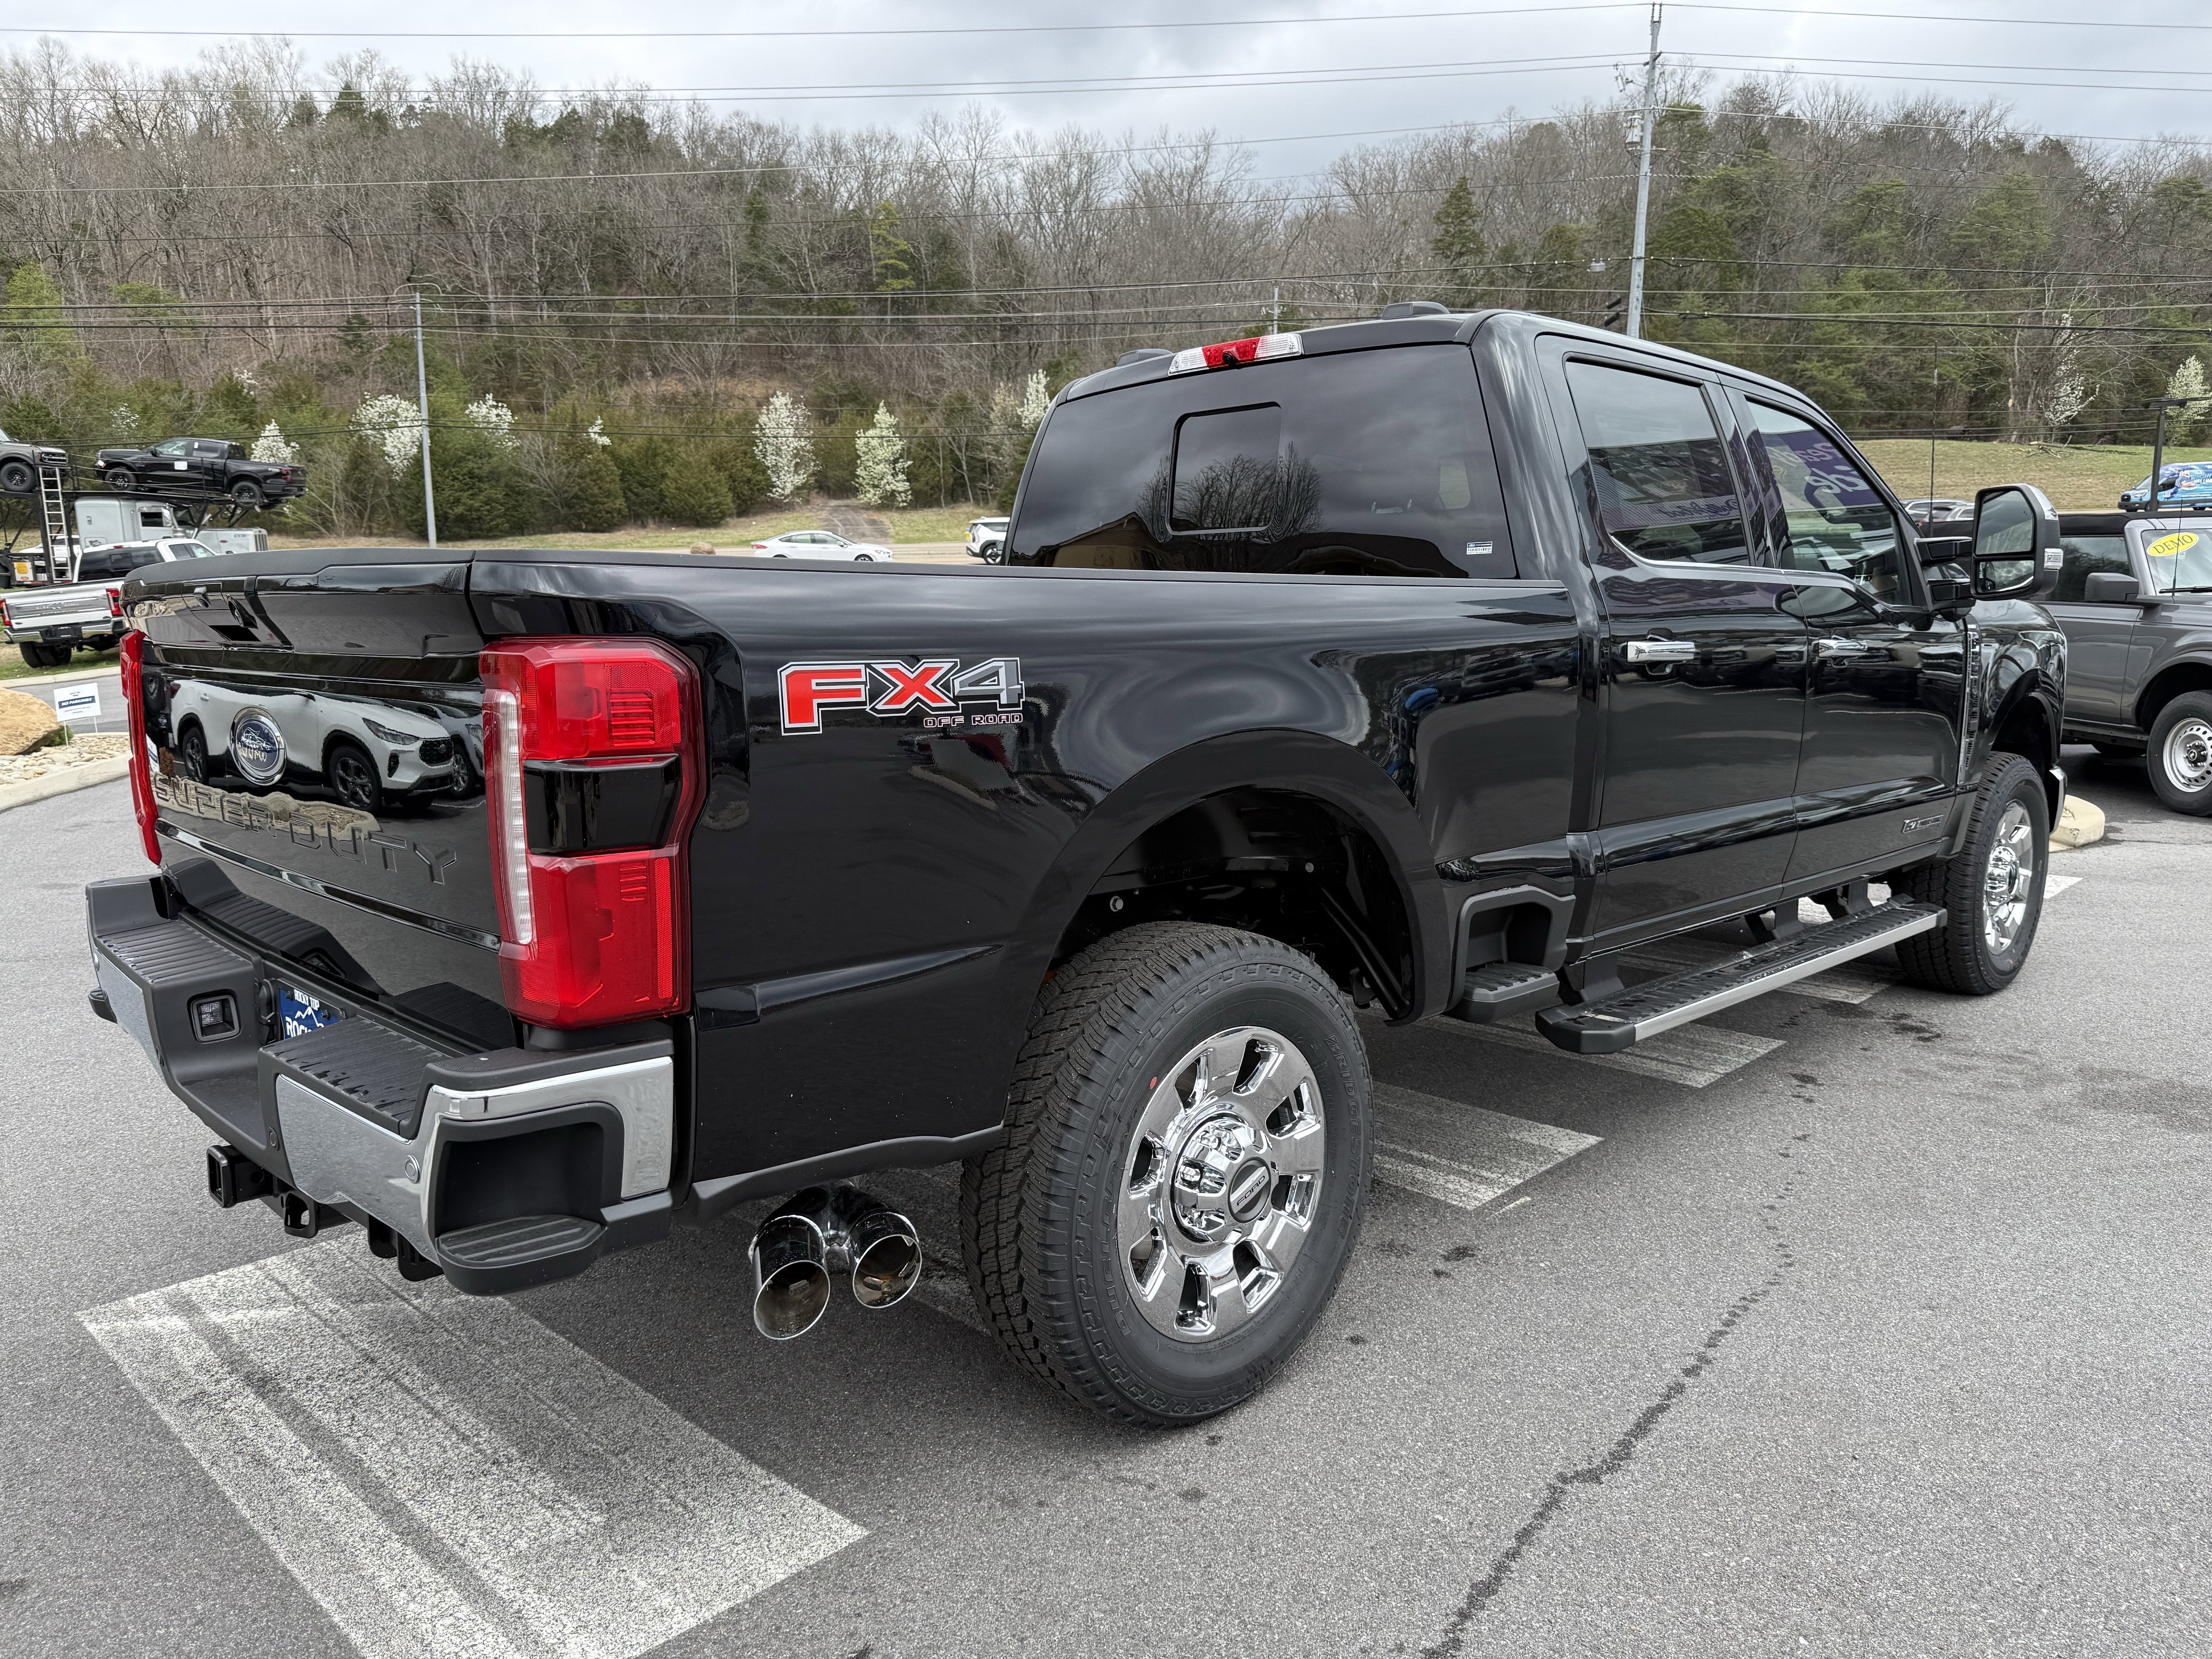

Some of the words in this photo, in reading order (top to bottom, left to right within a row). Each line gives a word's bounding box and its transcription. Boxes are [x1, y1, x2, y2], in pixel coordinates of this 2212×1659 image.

[2153, 535, 2193, 554] DEMO
[777, 657, 1025, 736] FX4
[923, 716, 964, 728] OFF
[971, 713, 1023, 725] ROAD
[155, 773, 277, 838] SUPER
[289, 811, 457, 885] DUTY
[294, 989, 309, 1006] ROCKY
[309, 997, 320, 1011] TOP
[1324, 1034, 1363, 1240] BRIDGESTONE
[1237, 1175, 1265, 1206] FORD
